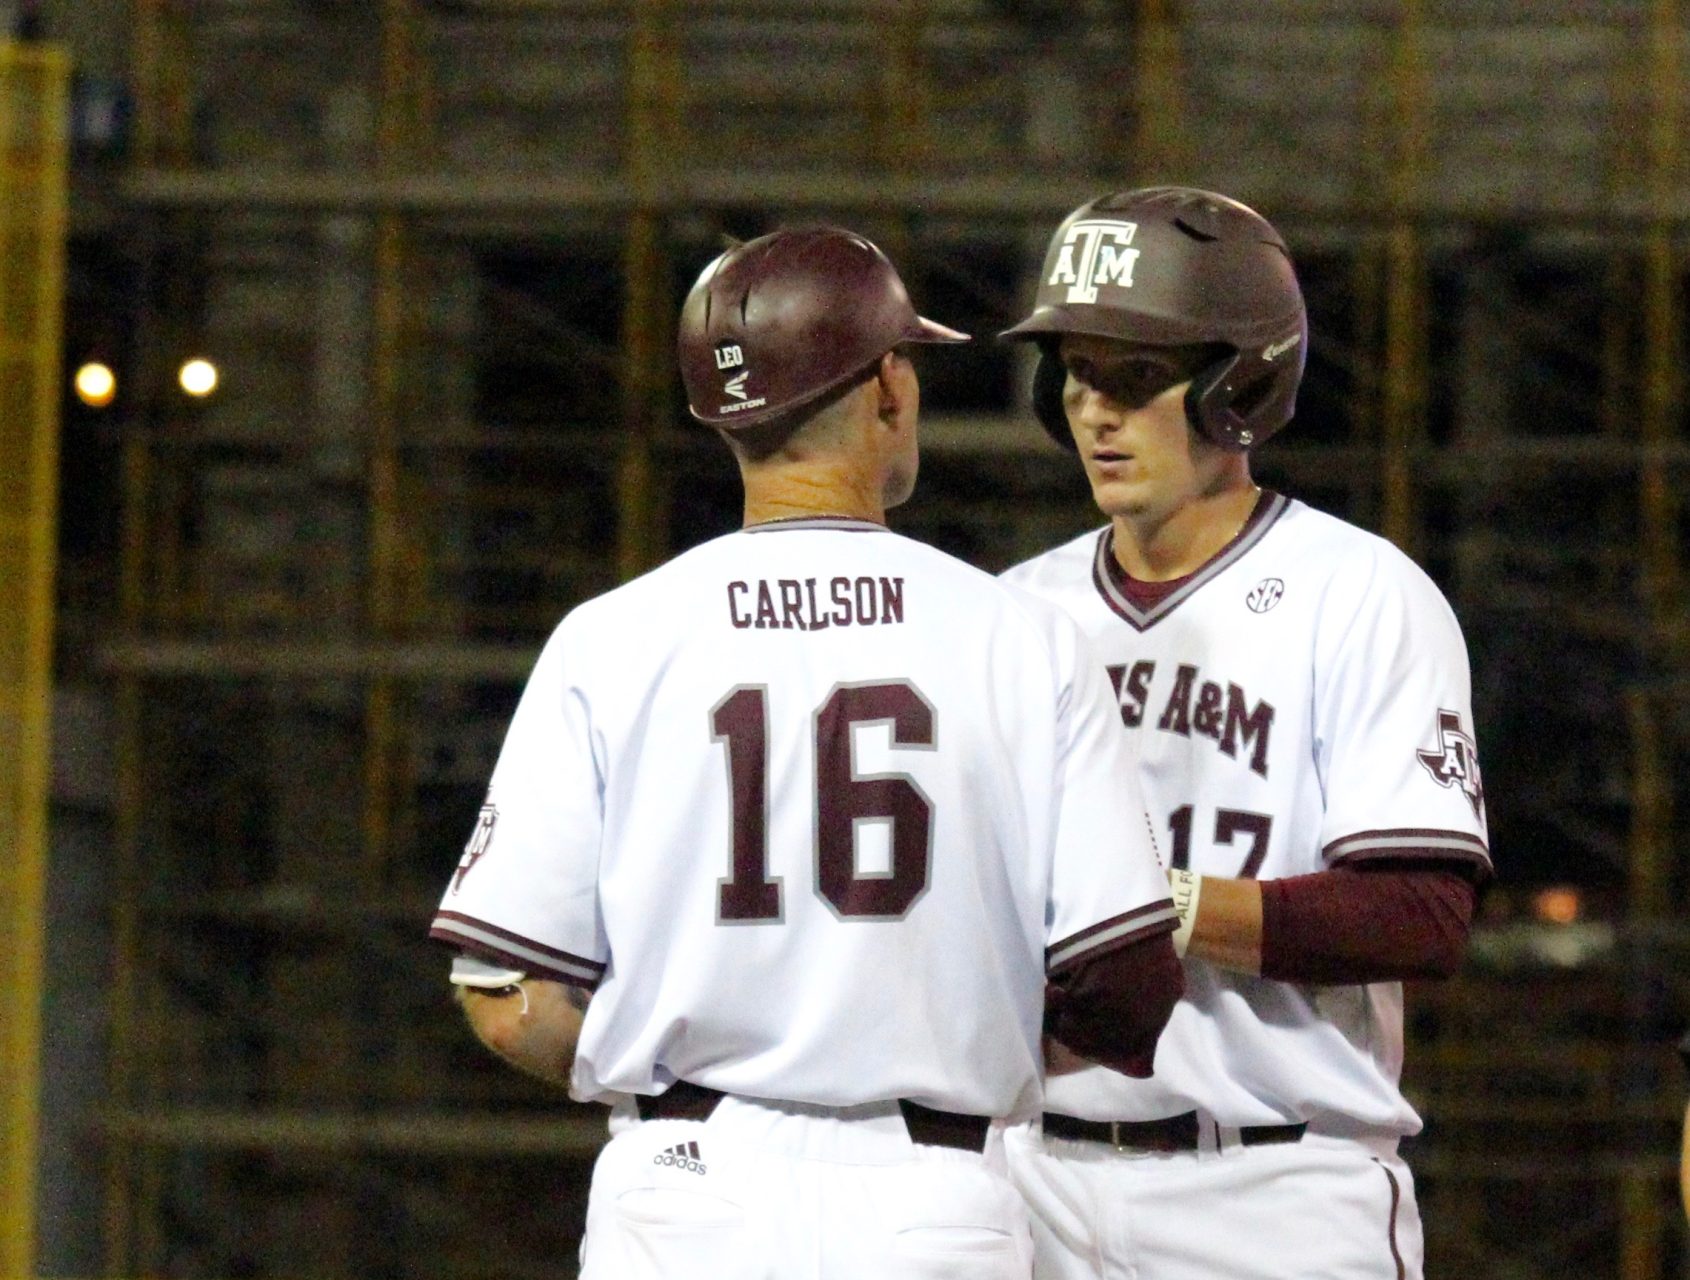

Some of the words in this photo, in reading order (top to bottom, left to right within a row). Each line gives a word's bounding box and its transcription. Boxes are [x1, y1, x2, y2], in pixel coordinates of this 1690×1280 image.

[727, 576, 905, 631] CARLSON
[1156, 662, 1277, 781] A&M
[707, 677, 939, 926] 16
[1166, 803, 1275, 881] 17
[653, 1153, 708, 1176] adidas
